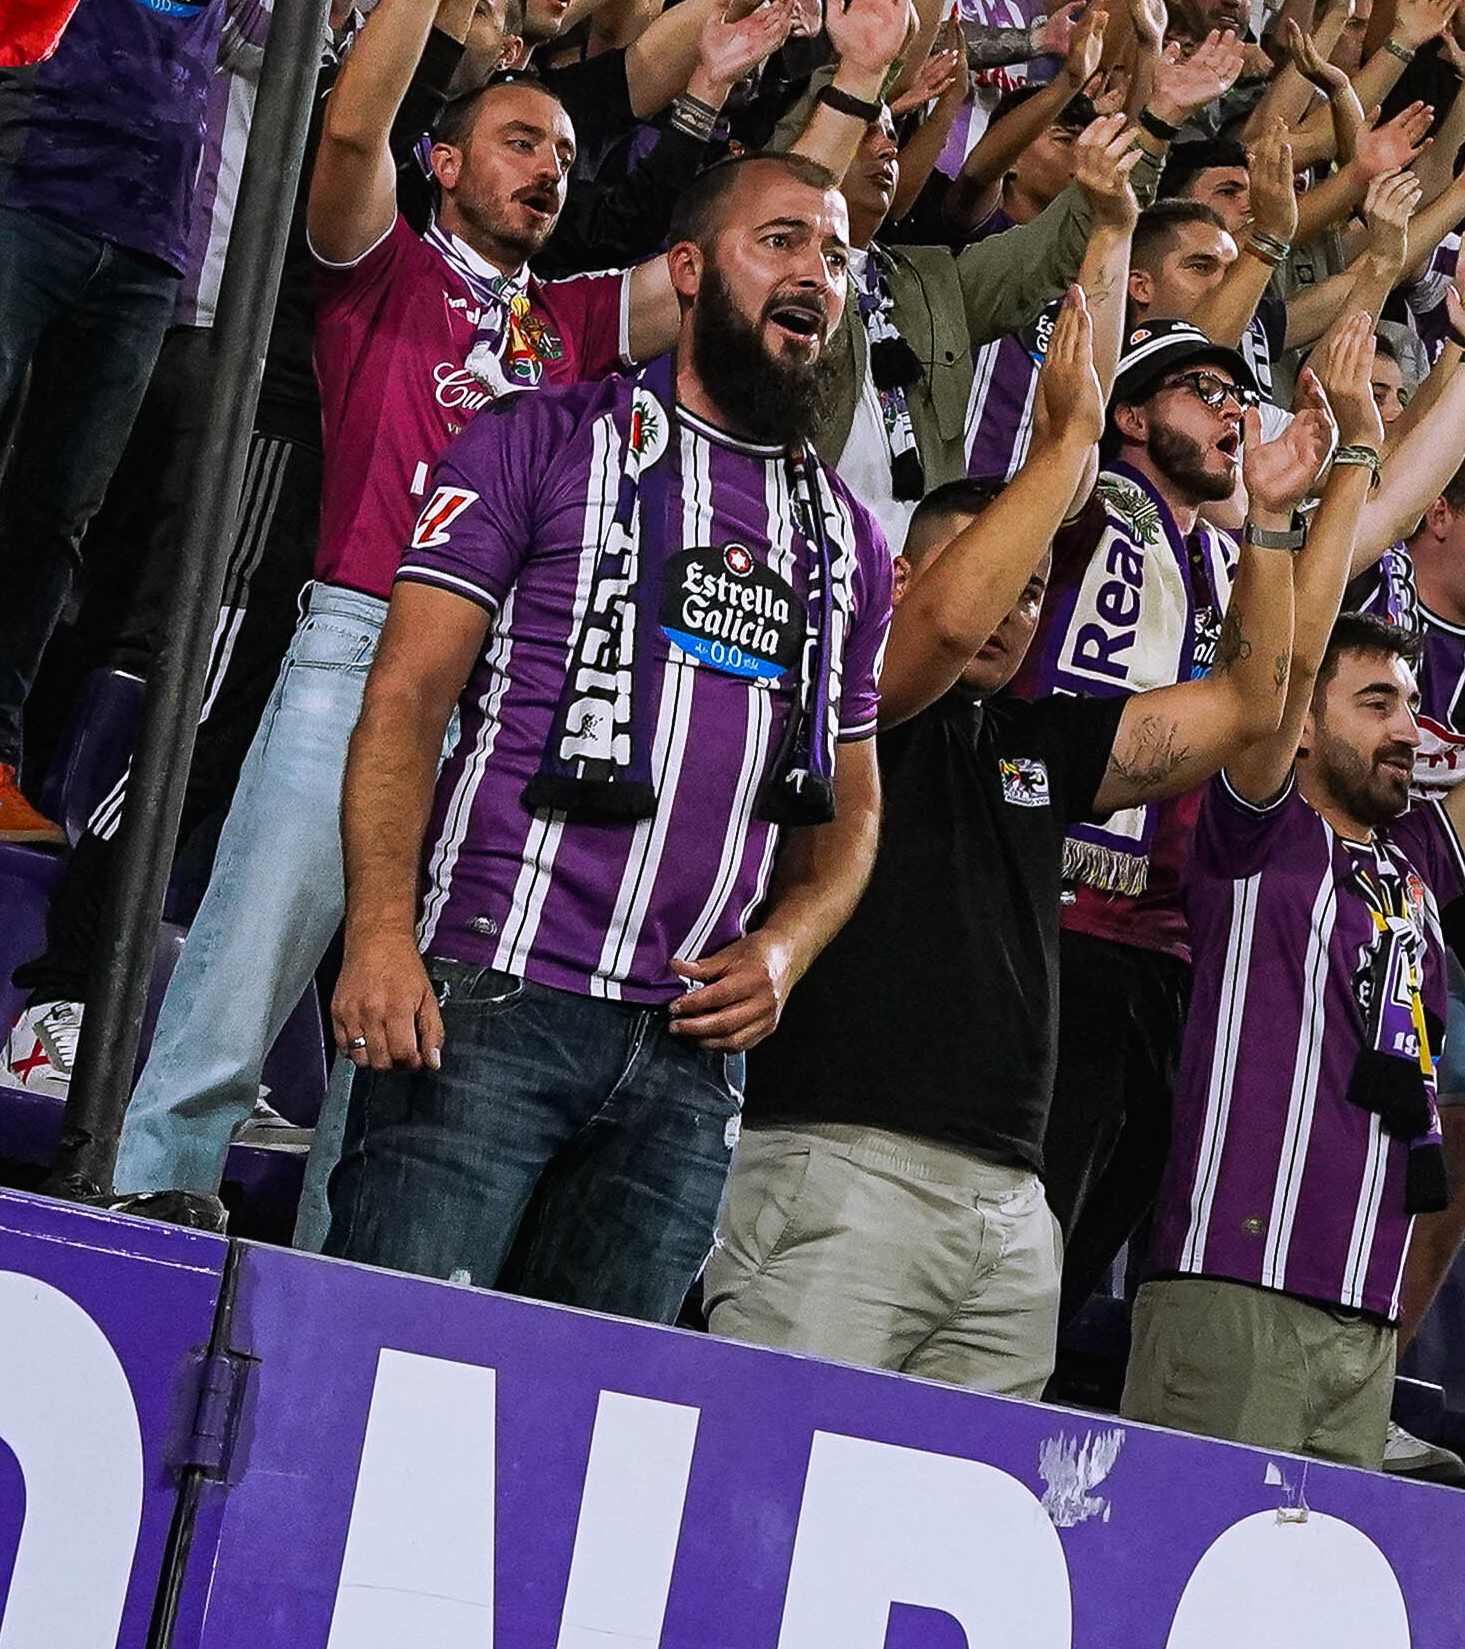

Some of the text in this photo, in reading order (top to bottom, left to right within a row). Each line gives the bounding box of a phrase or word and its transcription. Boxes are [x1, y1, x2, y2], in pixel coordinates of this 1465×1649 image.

[681, 561, 789, 624] Estrella
[1070, 537, 1145, 681] Rea
[682, 593, 780, 656] Galicia
